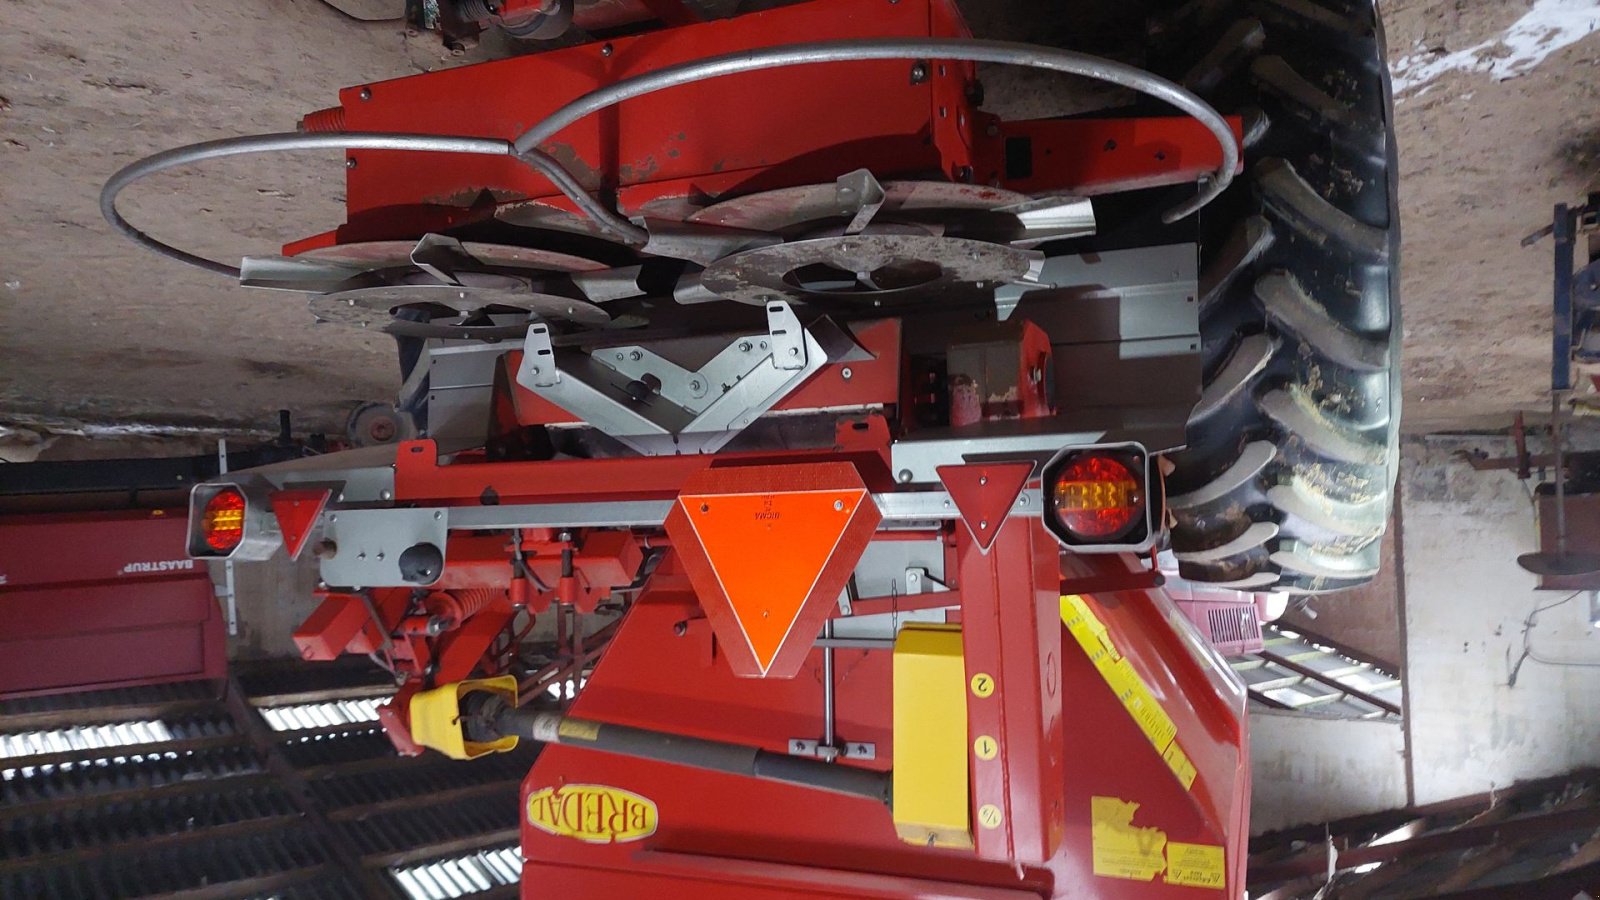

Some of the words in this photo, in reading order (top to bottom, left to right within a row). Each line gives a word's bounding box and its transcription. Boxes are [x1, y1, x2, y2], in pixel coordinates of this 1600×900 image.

[123, 559, 194, 574] BAASTRUP
[977, 677, 987, 692] 2
[983, 739, 991, 755] 1
[532, 791, 647, 834] BREDAL
